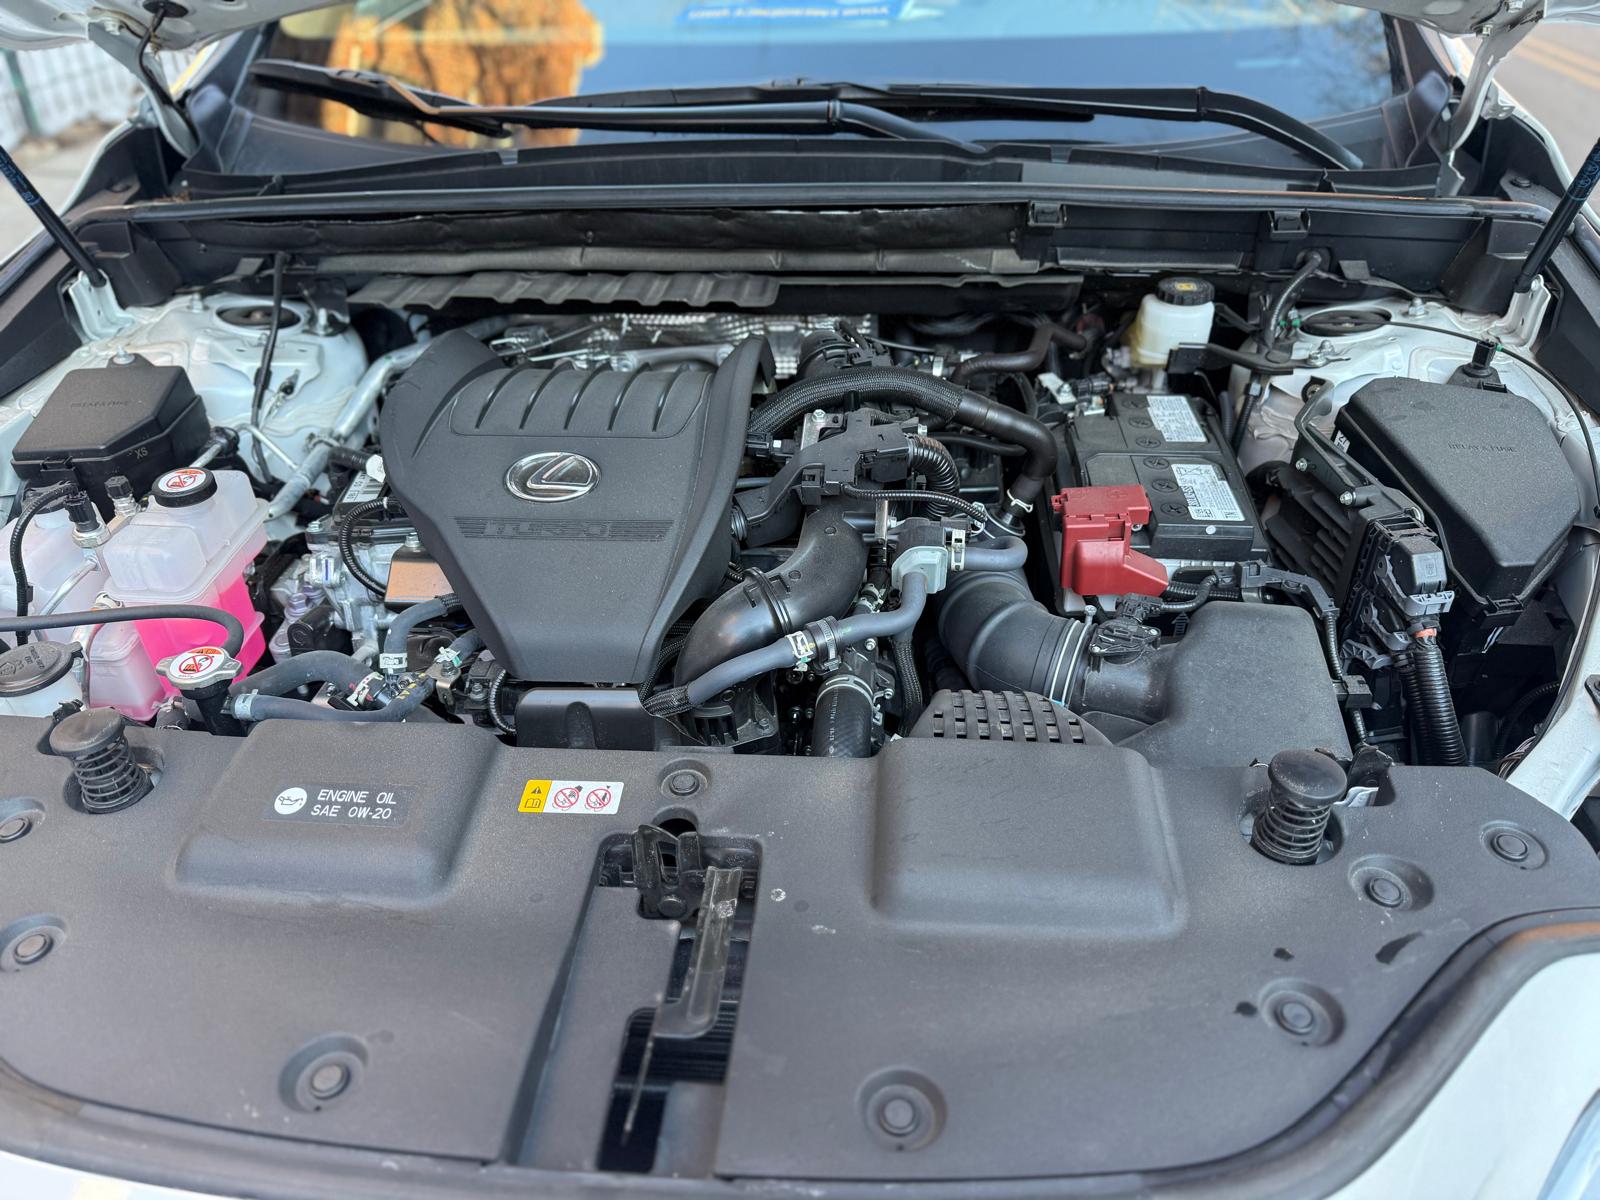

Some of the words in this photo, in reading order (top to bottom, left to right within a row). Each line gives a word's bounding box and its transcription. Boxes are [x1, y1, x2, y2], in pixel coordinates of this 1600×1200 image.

[317, 789, 369, 804] ENGINE
[376, 791, 397, 805] OIL
[311, 804, 341, 817] SAE
[348, 806, 392, 819] 0W-20
